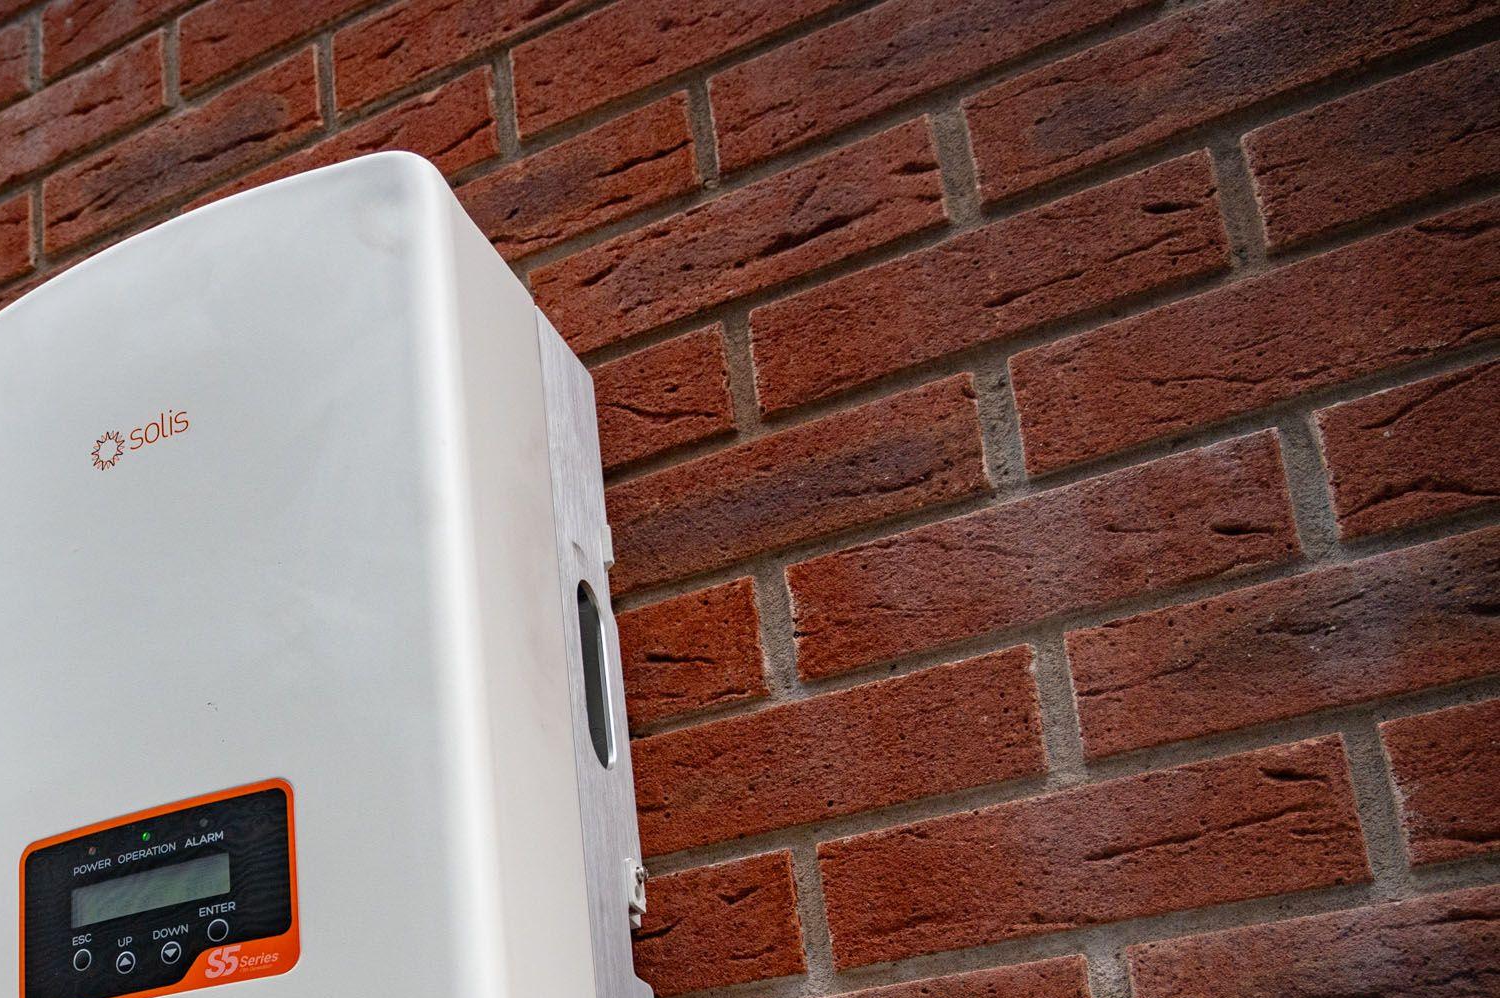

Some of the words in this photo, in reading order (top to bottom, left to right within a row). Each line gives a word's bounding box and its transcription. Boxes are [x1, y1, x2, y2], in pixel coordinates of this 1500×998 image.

[130, 410, 188, 450] solis
[73, 858, 111, 876] POWER
[118, 842, 176, 864] OPERATION
[184, 830, 224, 848] ALARM
[198, 902, 236, 918] ENTER
[72, 934, 92, 946] ESC
[152, 924, 188, 940] DOWN
[118, 936, 132, 948] UP
[204, 946, 242, 978] S5
[240, 952, 278, 968] Series
